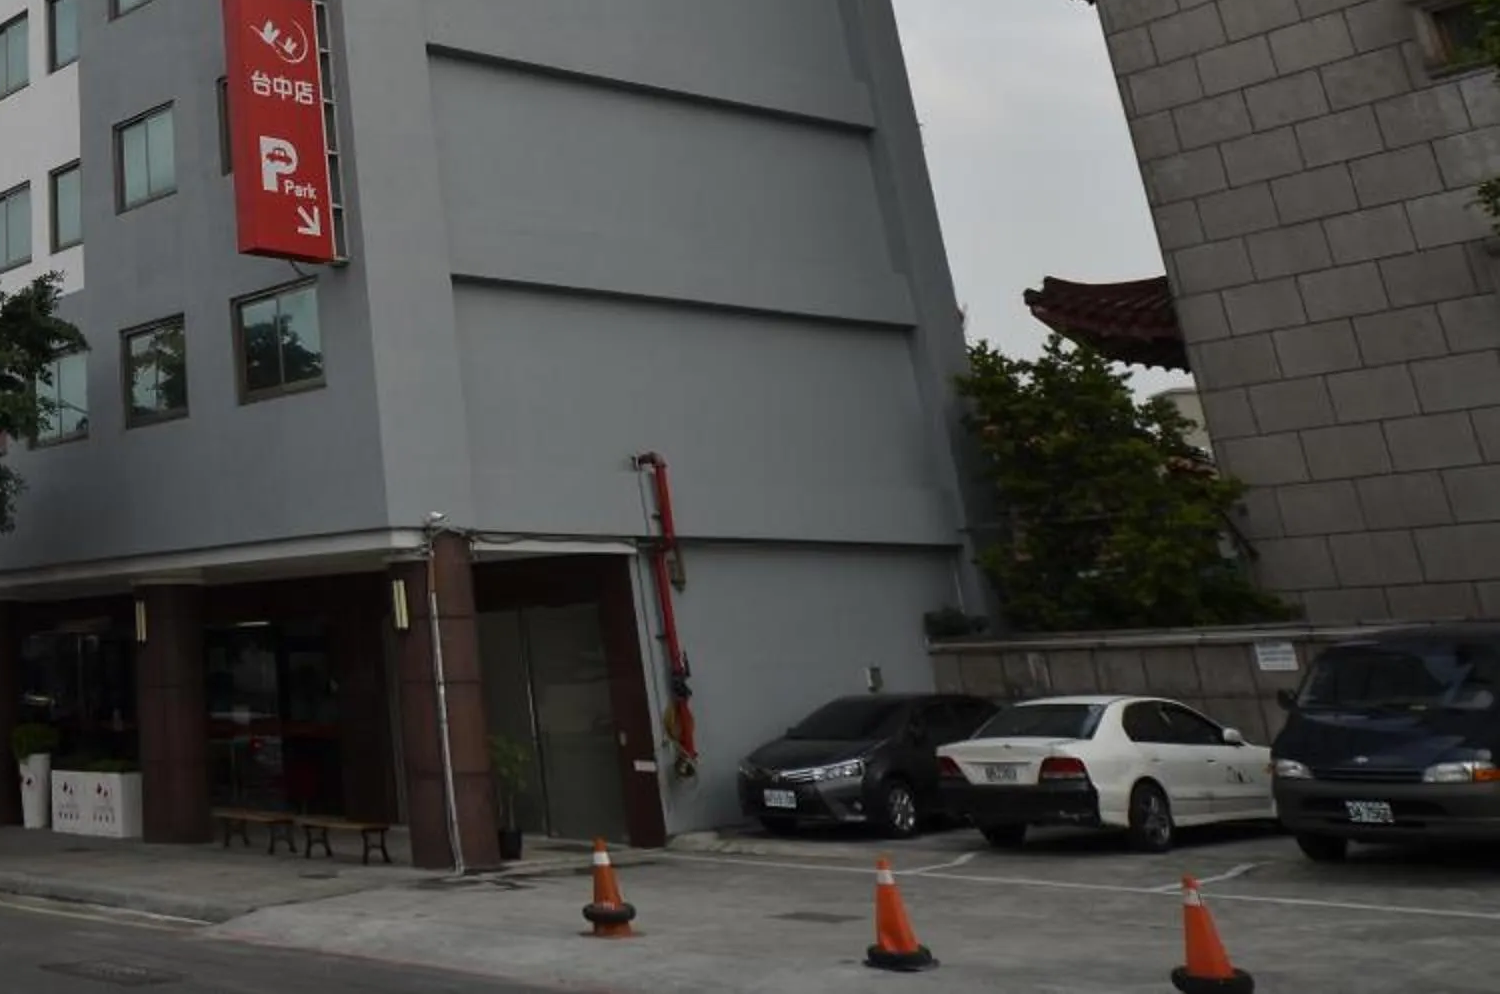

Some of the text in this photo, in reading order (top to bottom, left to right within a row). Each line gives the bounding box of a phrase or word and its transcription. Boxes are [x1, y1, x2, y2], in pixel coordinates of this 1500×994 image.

[251, 70, 314, 105] 台中店
[283, 179, 317, 200] Park
